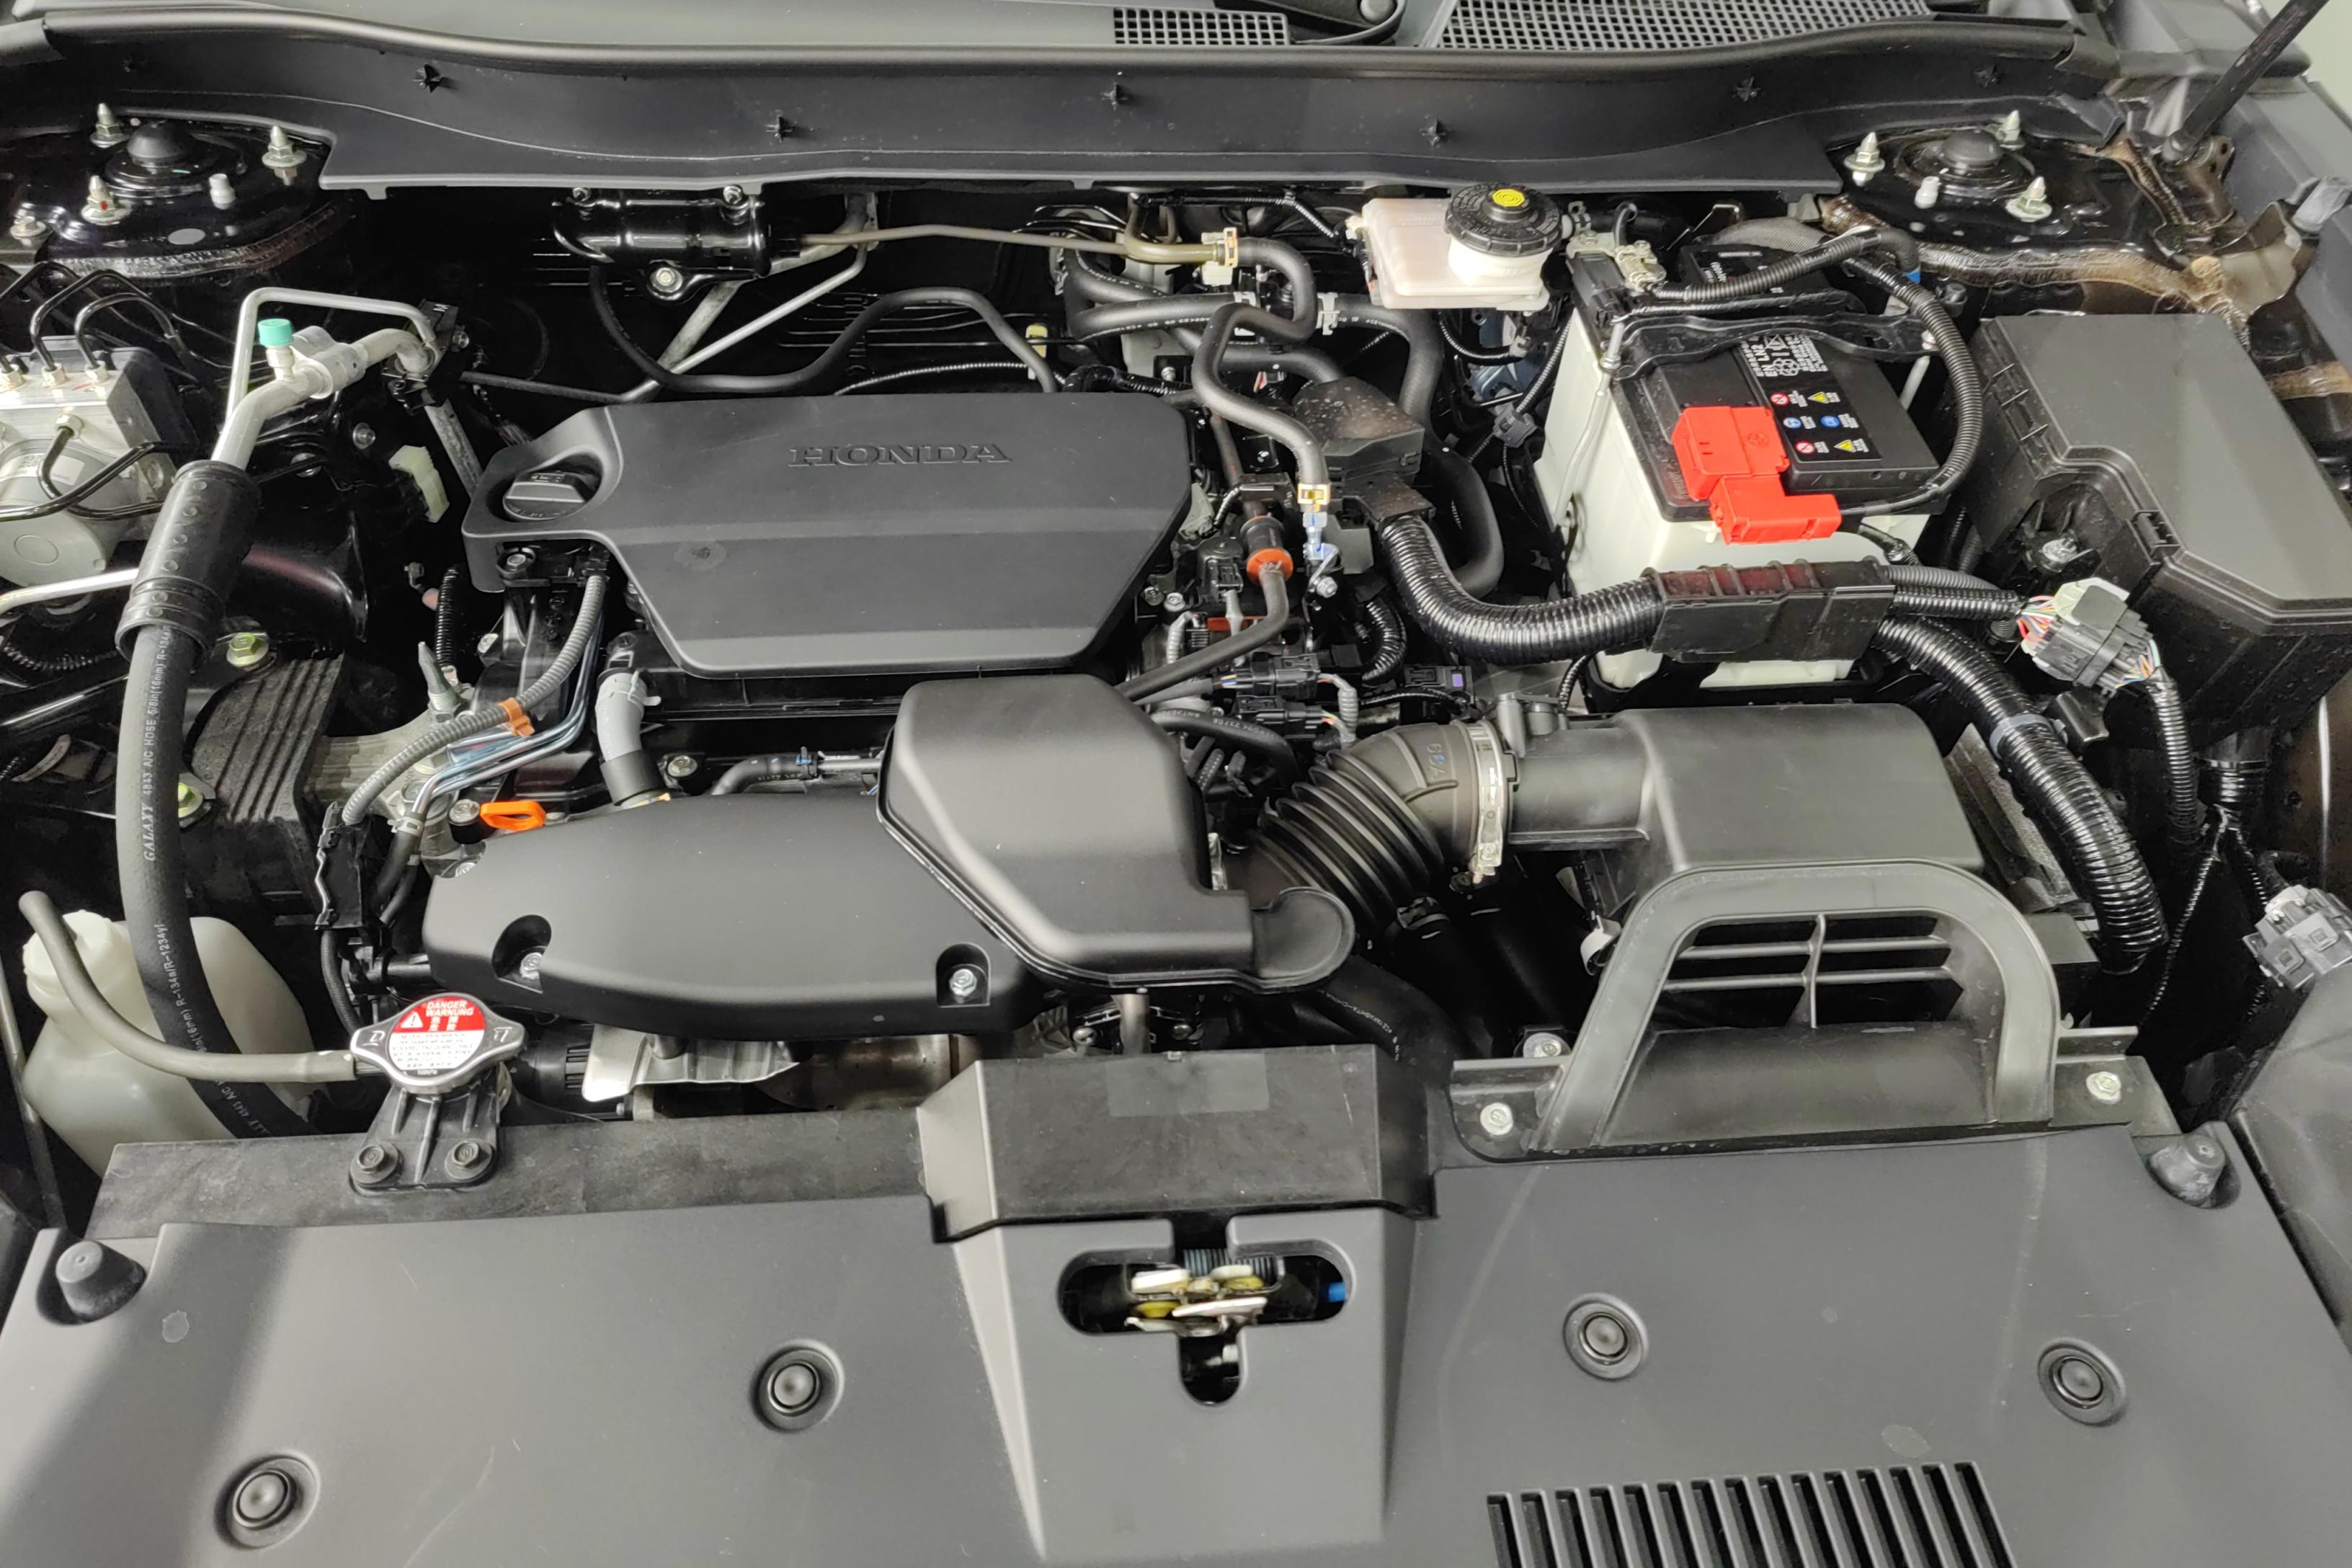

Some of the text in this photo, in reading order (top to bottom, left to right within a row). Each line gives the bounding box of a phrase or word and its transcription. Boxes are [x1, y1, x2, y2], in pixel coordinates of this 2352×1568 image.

[1761, 364, 1778, 378] EN
[788, 443, 1012, 467] HONDA
[145, 719, 157, 747] HOSE
[143, 750, 153, 767] A/C
[143, 772, 153, 796] 4843
[141, 802, 156, 861] GALAXY
[426, 1007, 474, 1017] WARNUNG
[427, 1000, 468, 1009] DANGER
